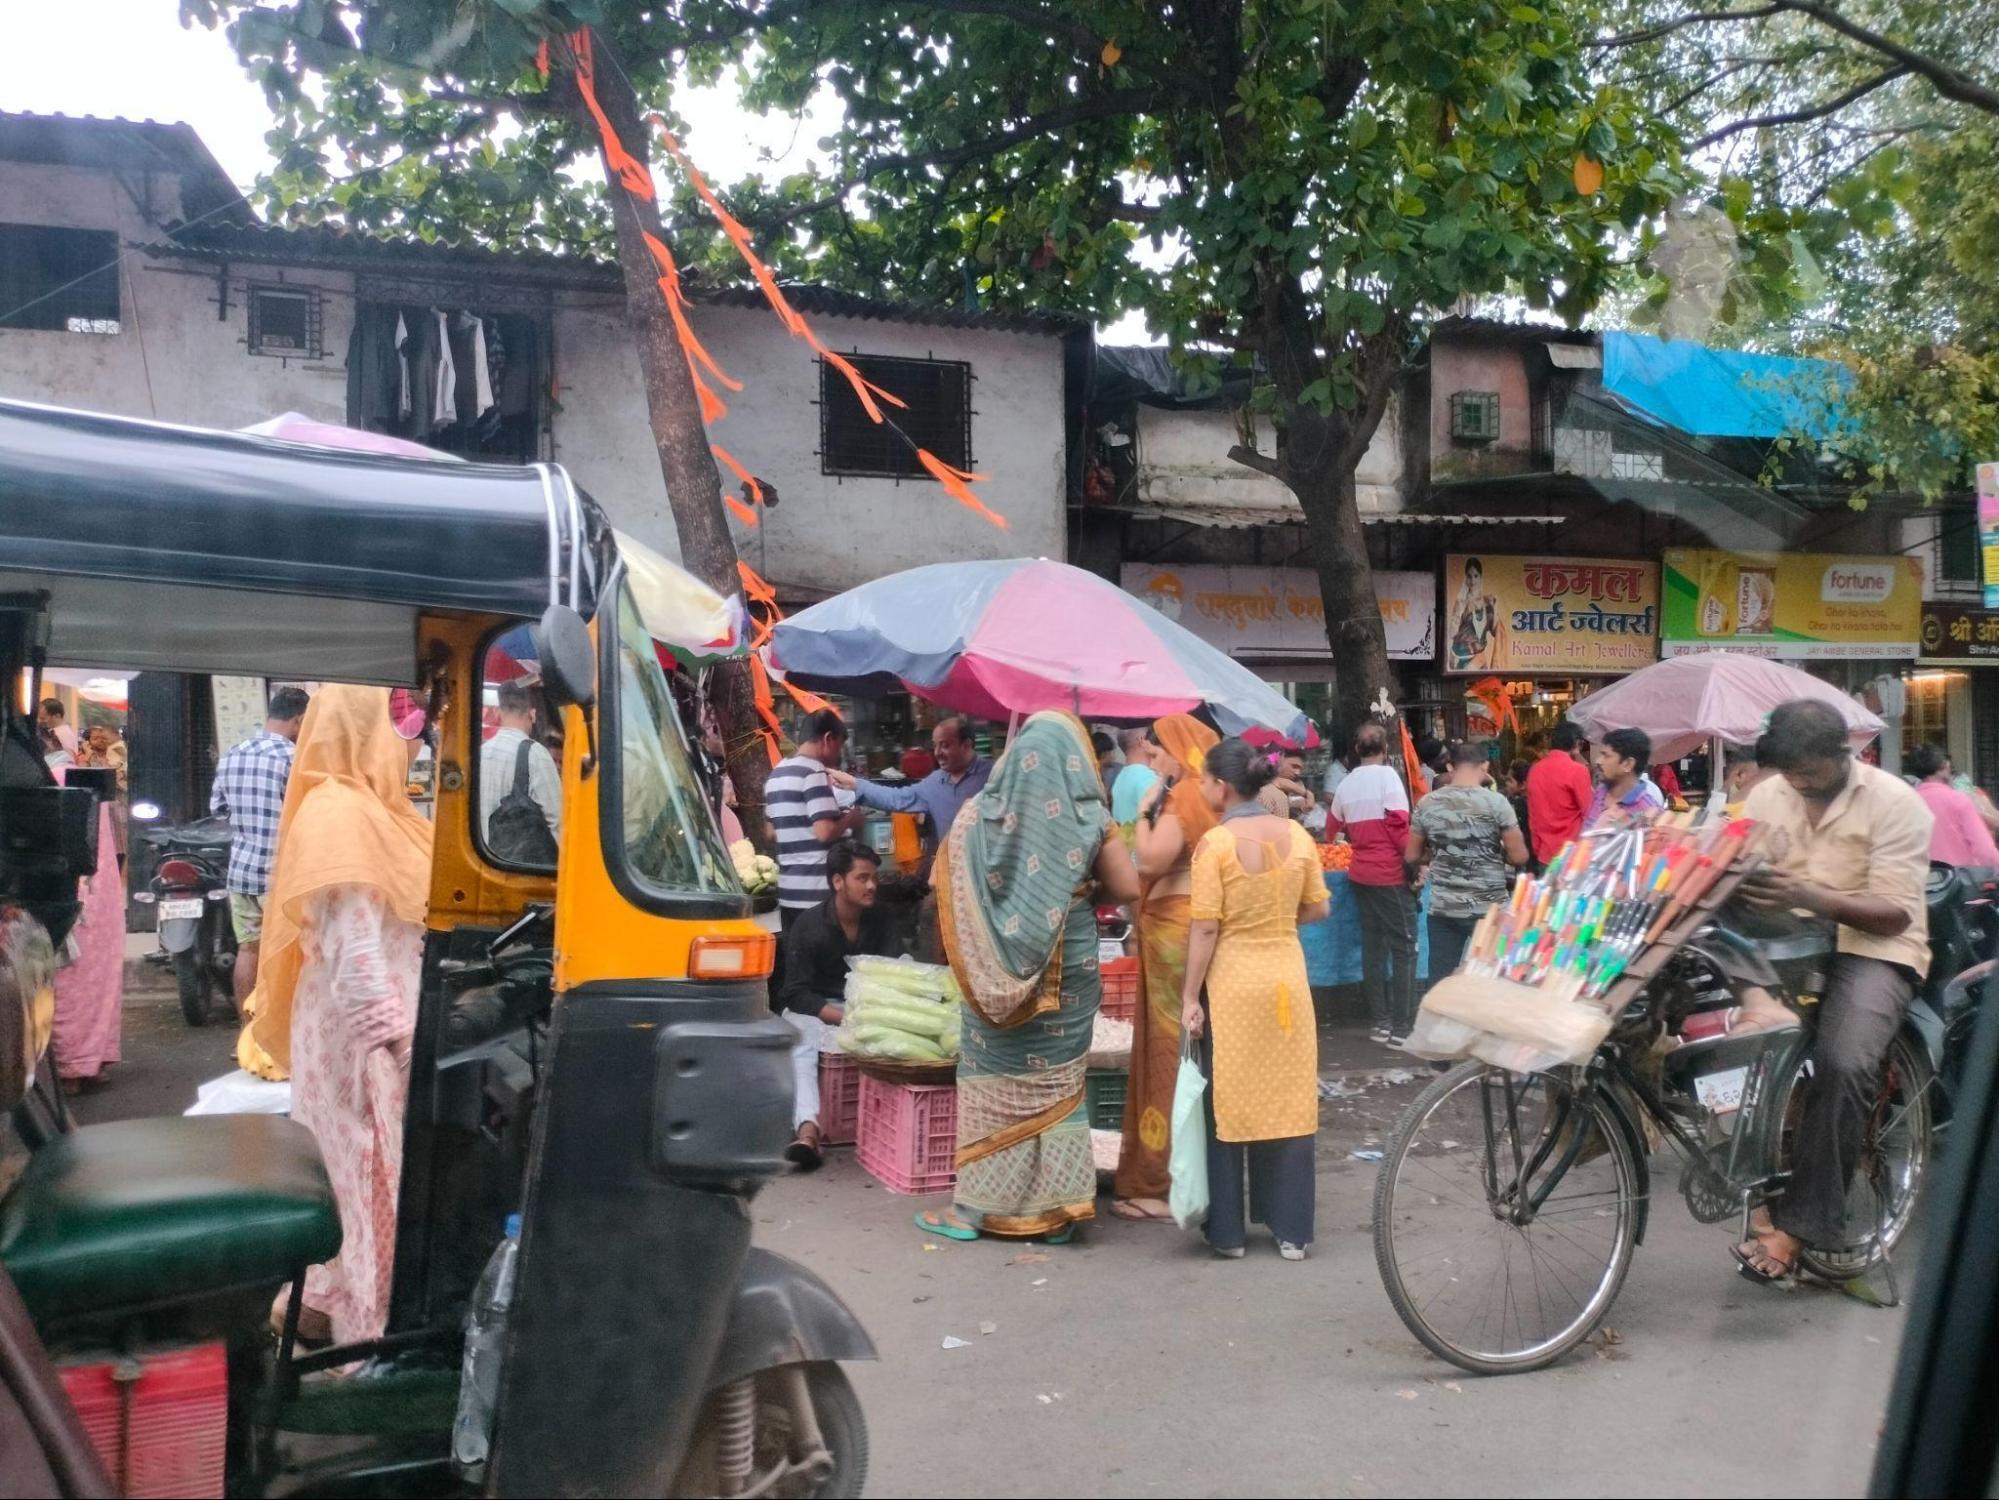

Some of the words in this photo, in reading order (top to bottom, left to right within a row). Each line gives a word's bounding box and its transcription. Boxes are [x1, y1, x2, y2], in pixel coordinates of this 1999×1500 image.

[1523, 564, 1645, 602] कमल
[1831, 570, 1886, 590] fortune
[1511, 602, 1566, 633] आर्ट
[1569, 603, 1654, 634] ज्वेलर्स
[1512, 641, 1556, 657] Kamal
[1565, 641, 1585, 657] Art
[1594, 642, 1650, 659] Jewellers
[1887, 646, 1913, 656] STORE
